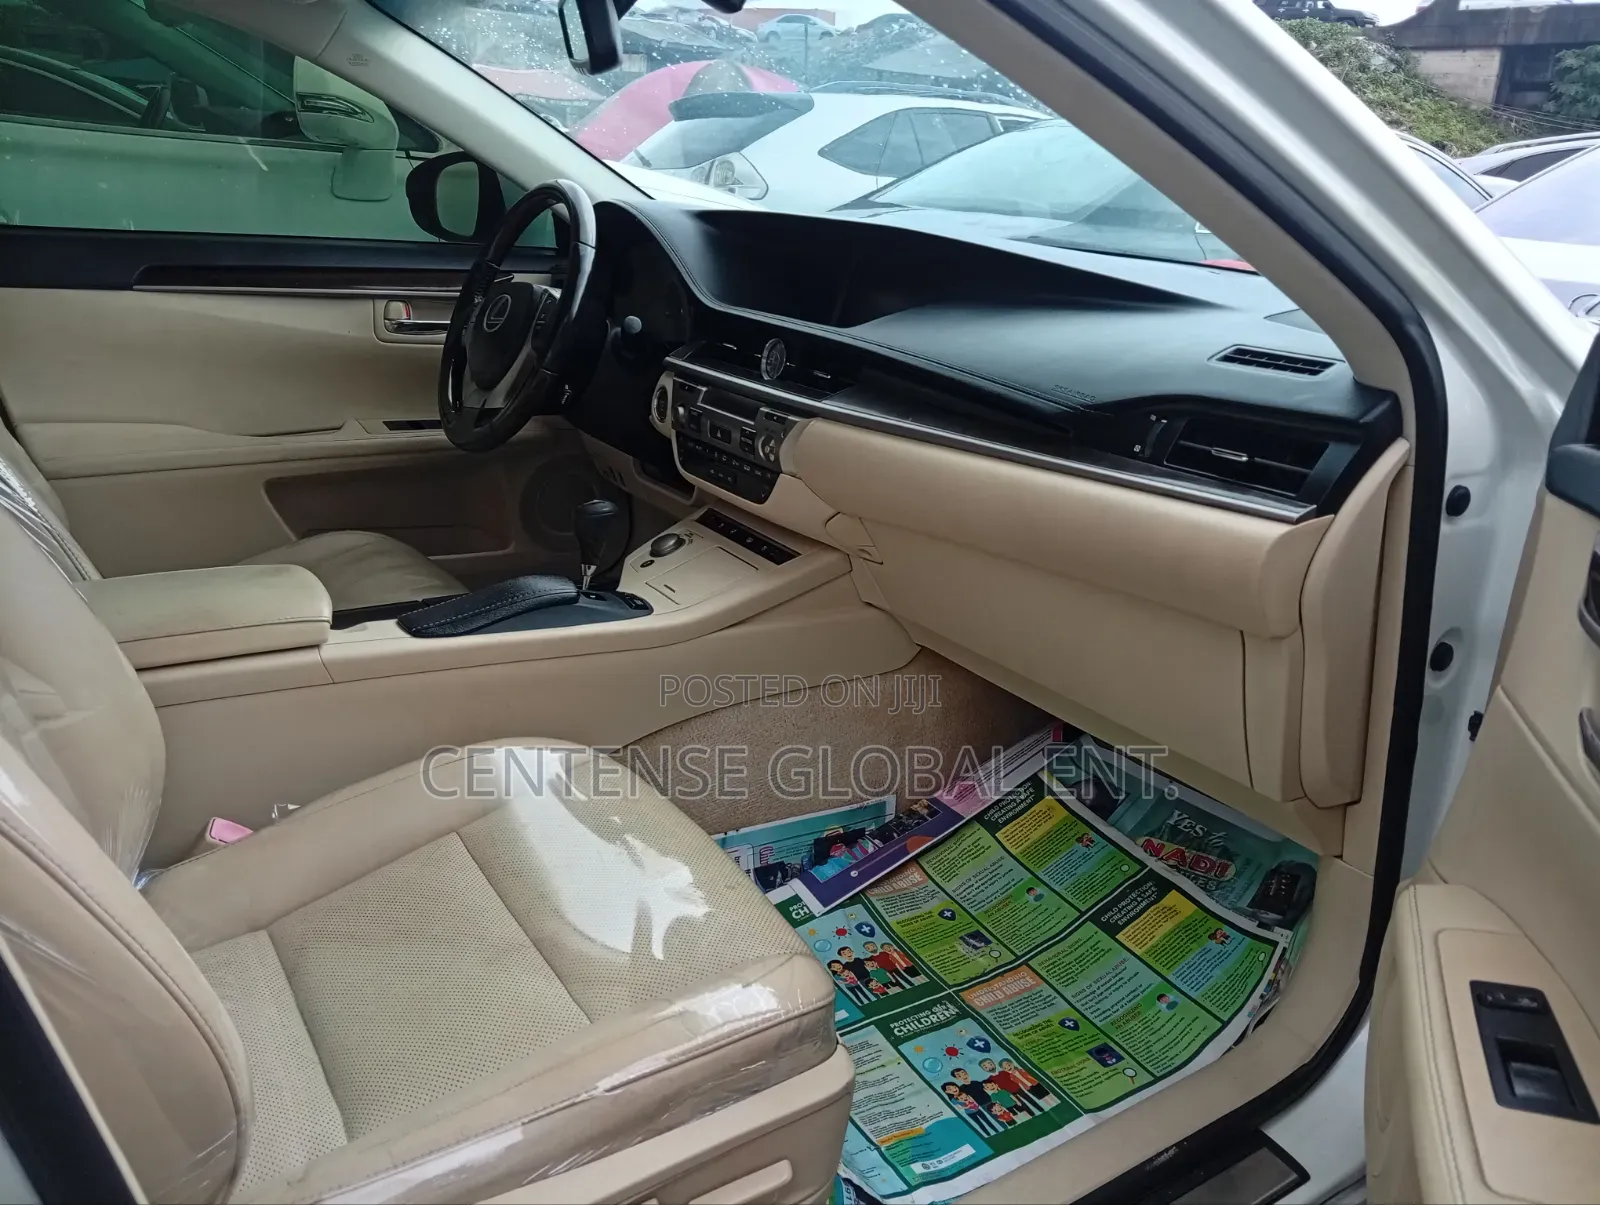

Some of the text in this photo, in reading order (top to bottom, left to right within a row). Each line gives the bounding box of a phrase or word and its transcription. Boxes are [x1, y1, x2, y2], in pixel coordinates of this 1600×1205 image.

[983, 806, 999, 819] CHILD
[991, 801, 1015, 820] CREATING
[1167, 809, 1207, 838] YES
[1141, 838, 1231, 879] NADI
[867, 872, 922, 894] CHILD ABUSE
[1101, 907, 1118, 921] CHILD
[1110, 900, 1137, 923] CREATING
[1142, 885, 1156, 898] SAFE
[968, 971, 1026, 998] UNDERSTANDING
[973, 976, 1035, 1005] CHILD ABUSE
[890, 1009, 930, 1028] PROTECTING
[894, 1006, 955, 1037] CHILDREN
